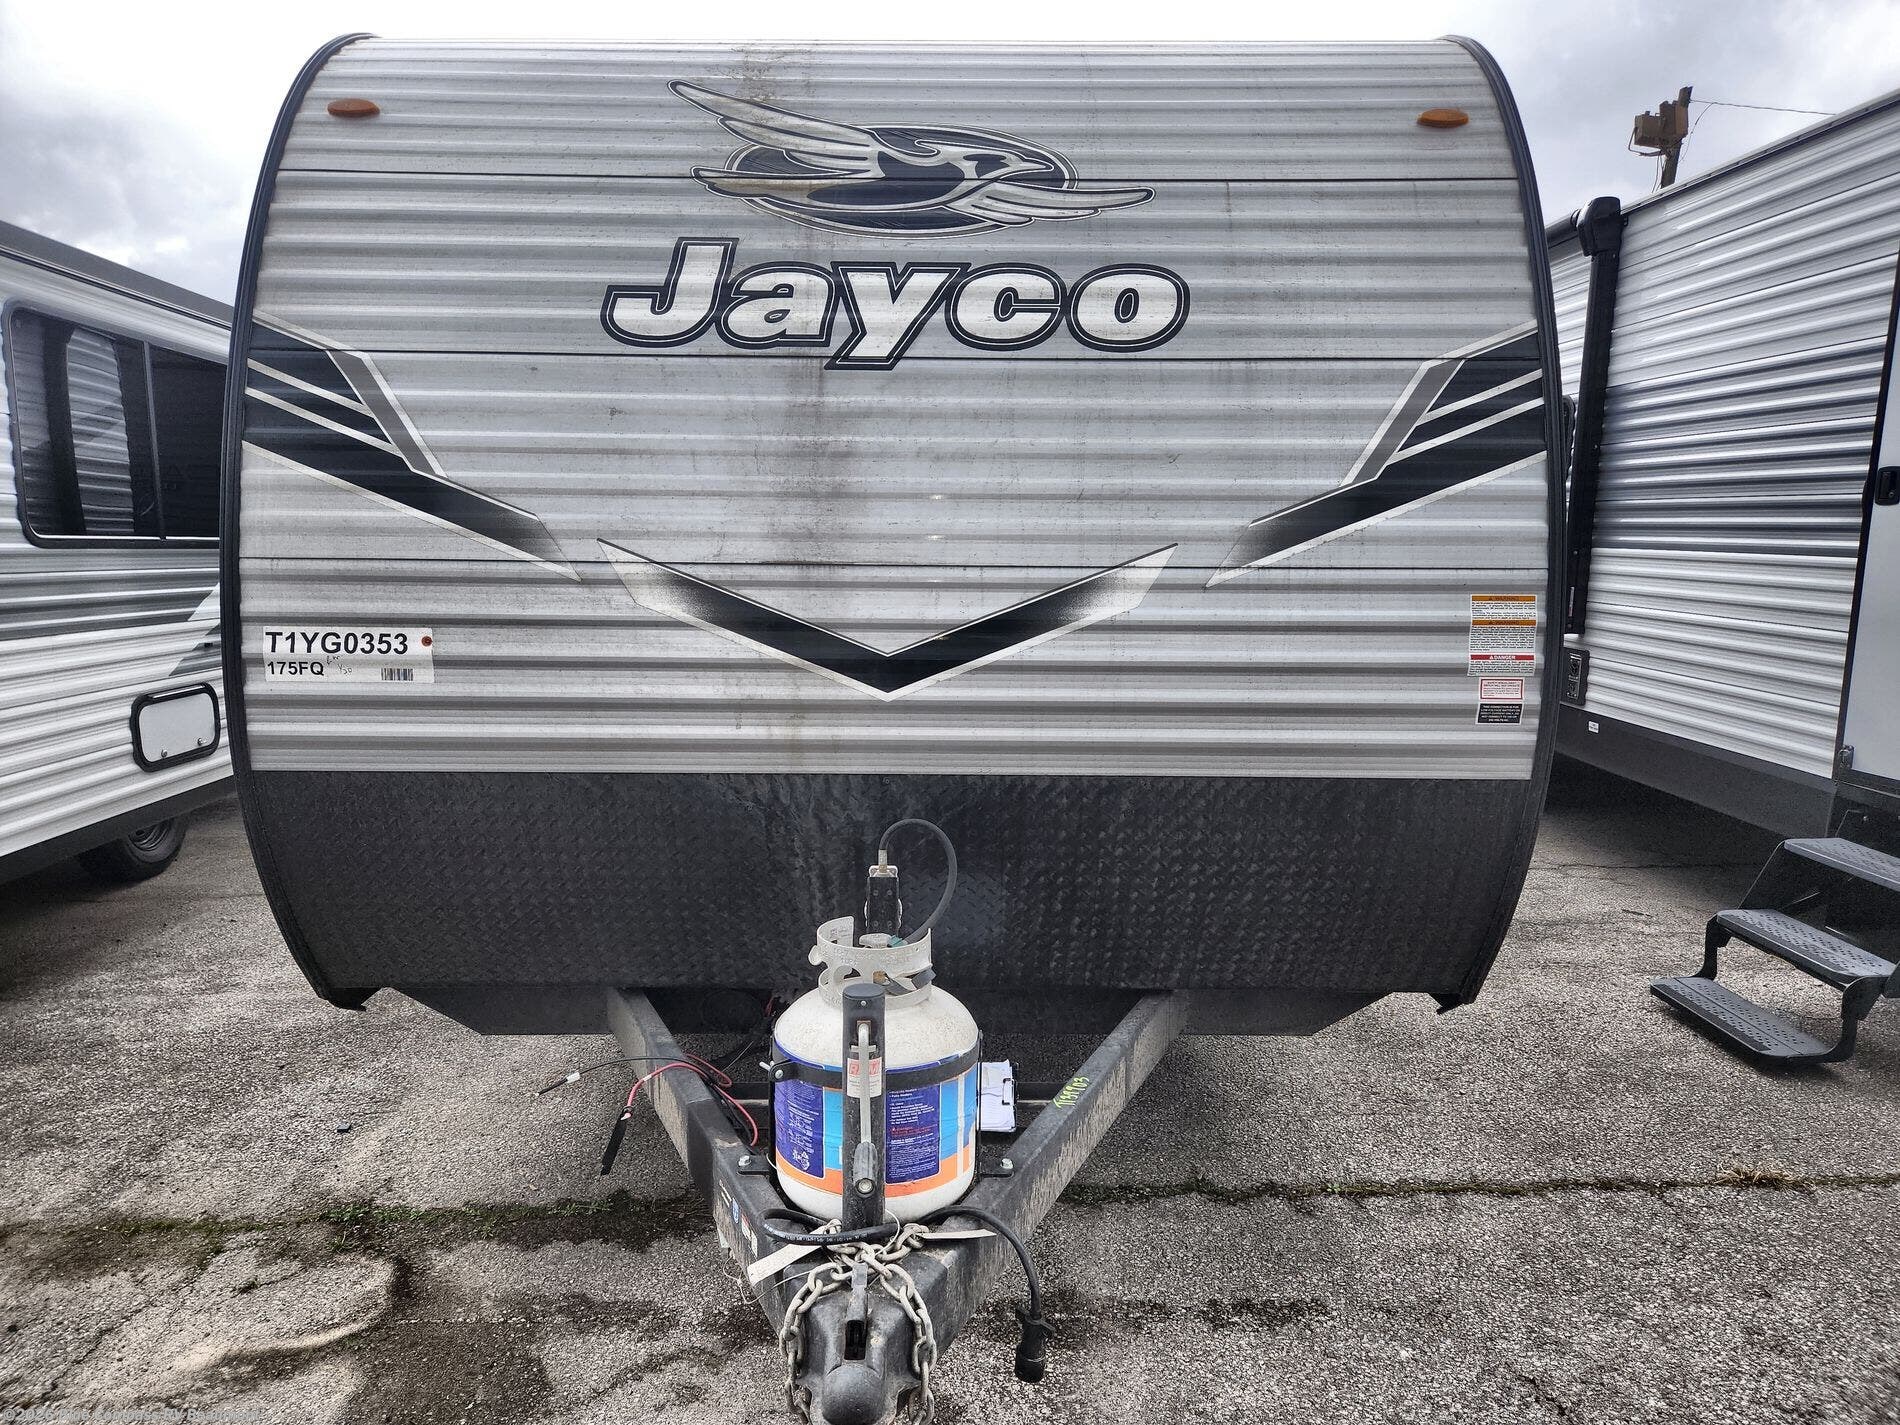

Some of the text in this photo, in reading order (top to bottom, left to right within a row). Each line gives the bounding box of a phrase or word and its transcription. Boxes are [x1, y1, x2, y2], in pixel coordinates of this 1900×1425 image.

[600, 237, 1190, 370] Jayco
[265, 631, 408, 654] T1YG0353
[267, 661, 324, 676] 175FQ
